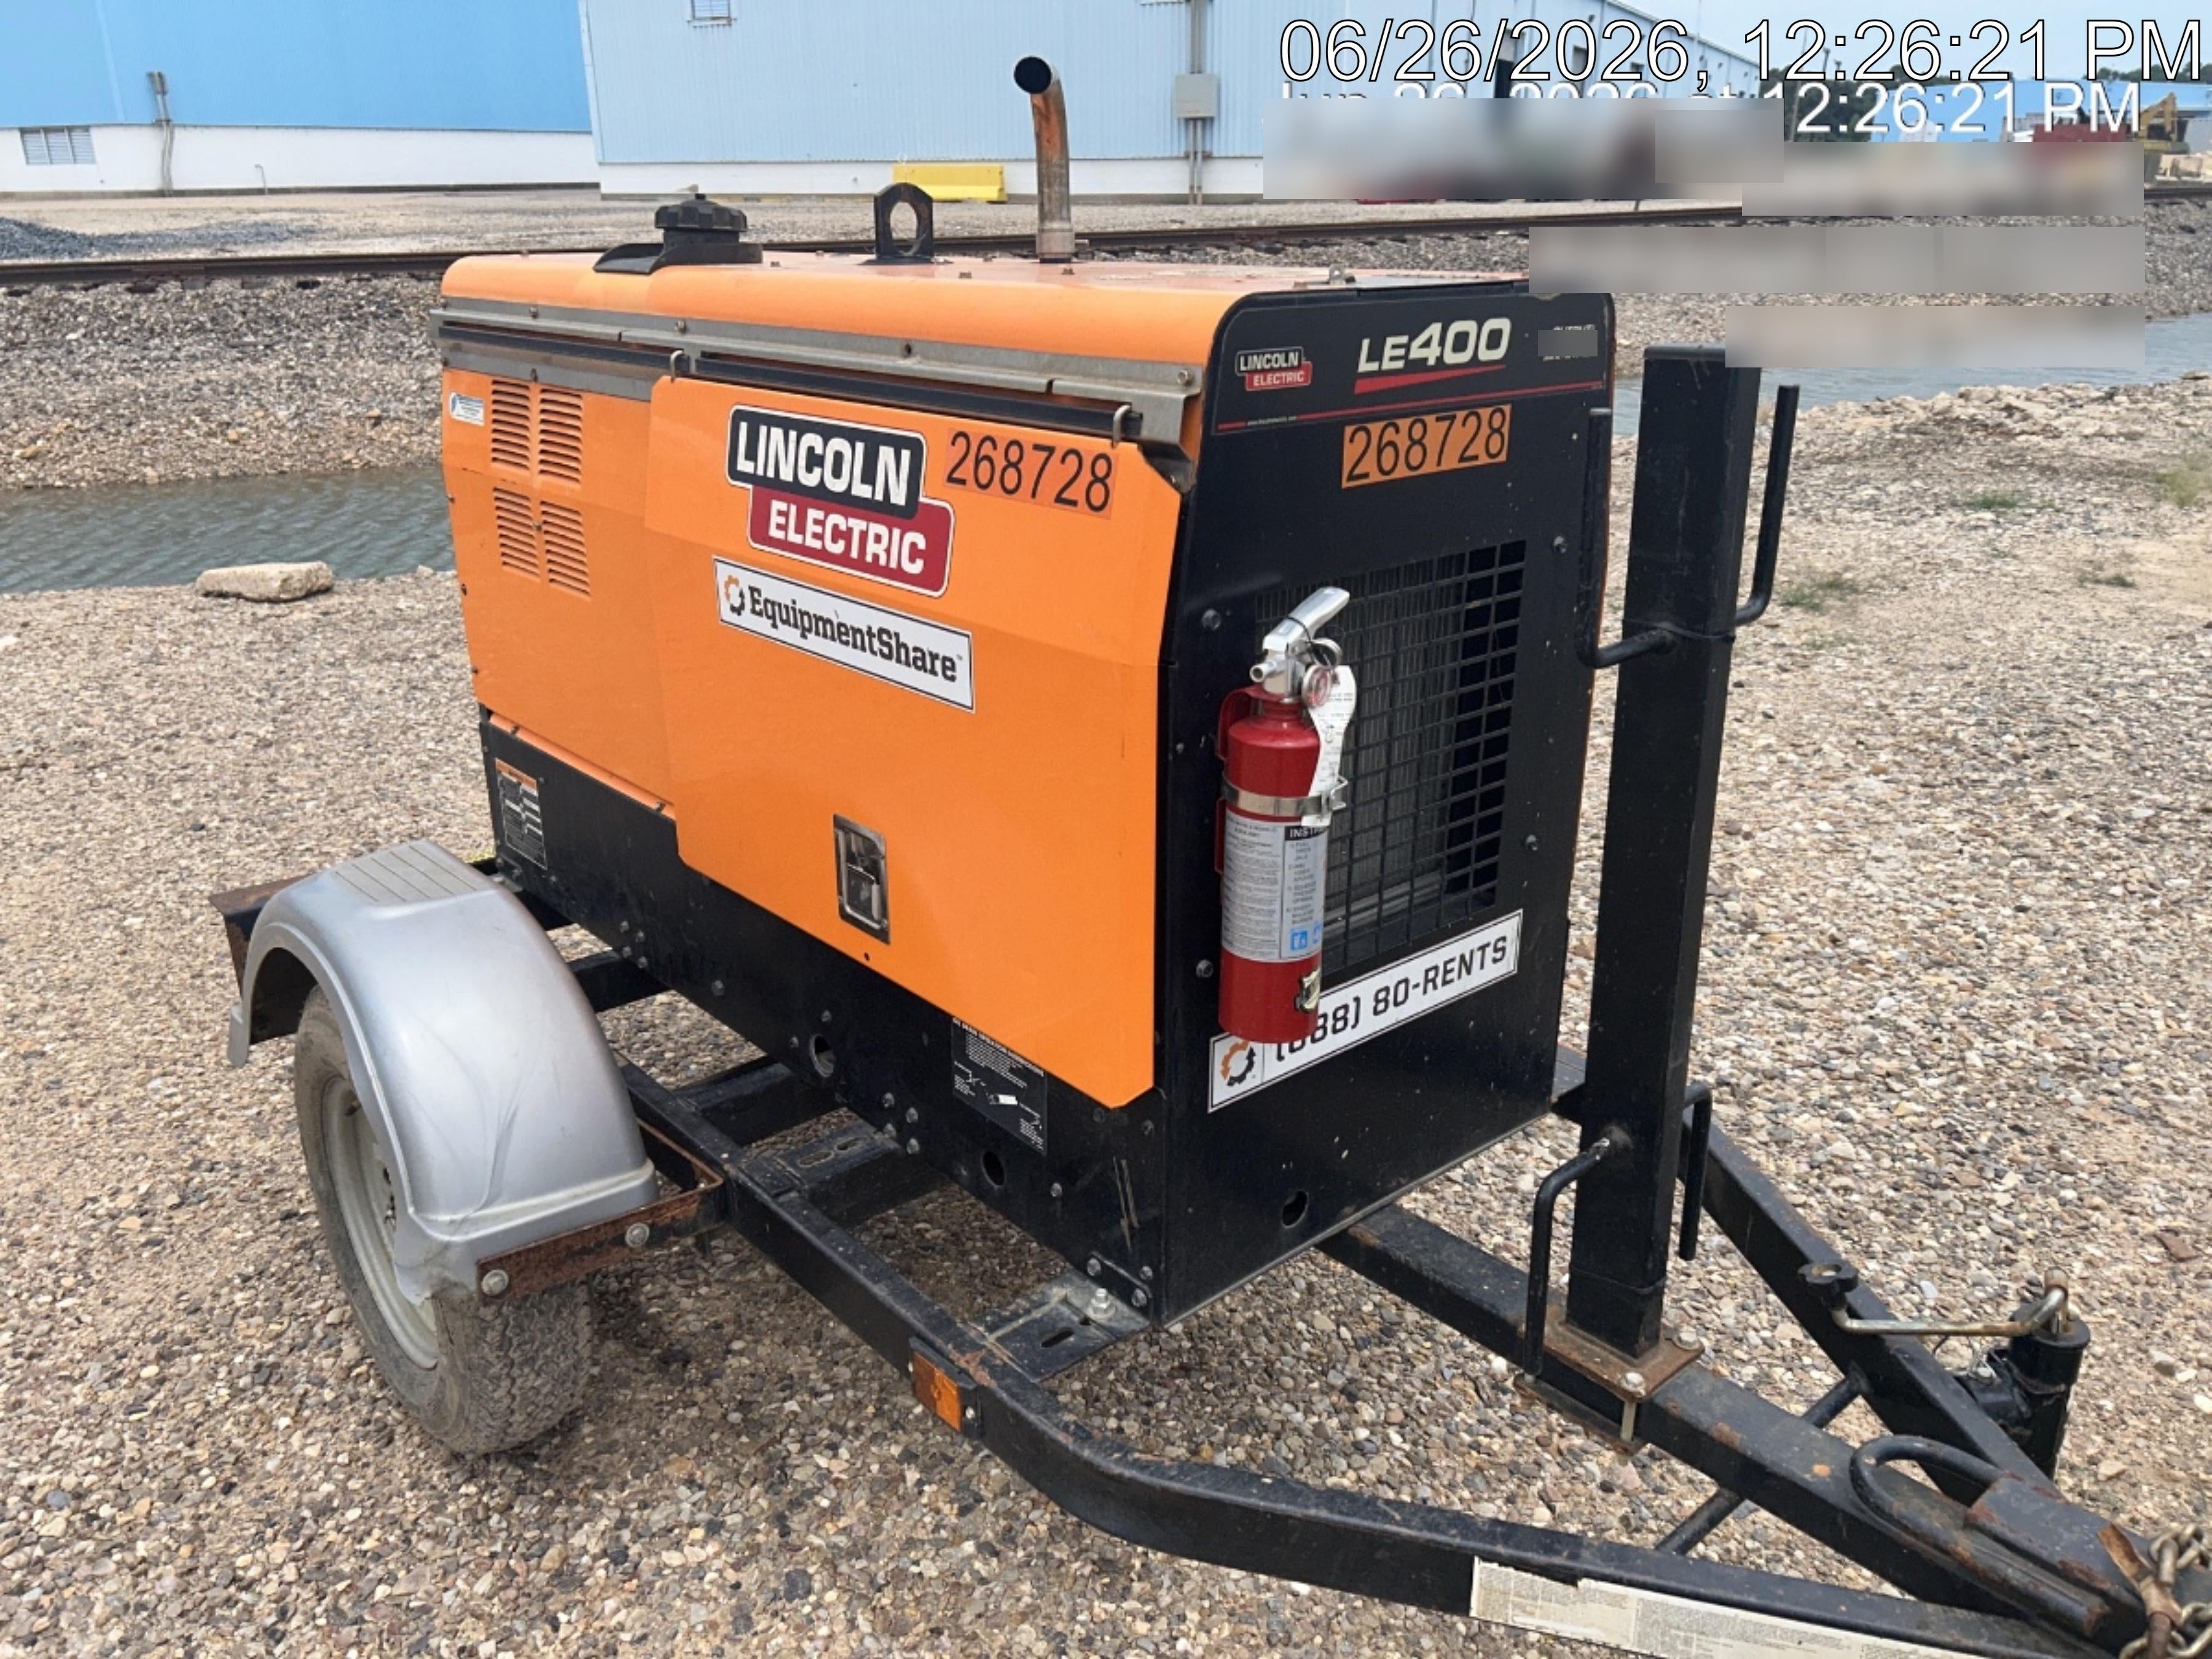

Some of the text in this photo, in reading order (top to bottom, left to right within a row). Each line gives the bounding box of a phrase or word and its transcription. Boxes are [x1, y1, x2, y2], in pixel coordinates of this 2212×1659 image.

[1240, 351, 1298, 371] LINCOLN
[1253, 370, 1305, 386] ELECTRIC
[1357, 317, 1512, 373] LE400
[737, 422, 911, 506] LINCOLN
[946, 430, 1113, 513] 268728
[1346, 406, 1507, 484] 268728
[769, 499, 926, 575] ELECTRIC
[1373, 935, 1507, 1017] 80-RENTS
